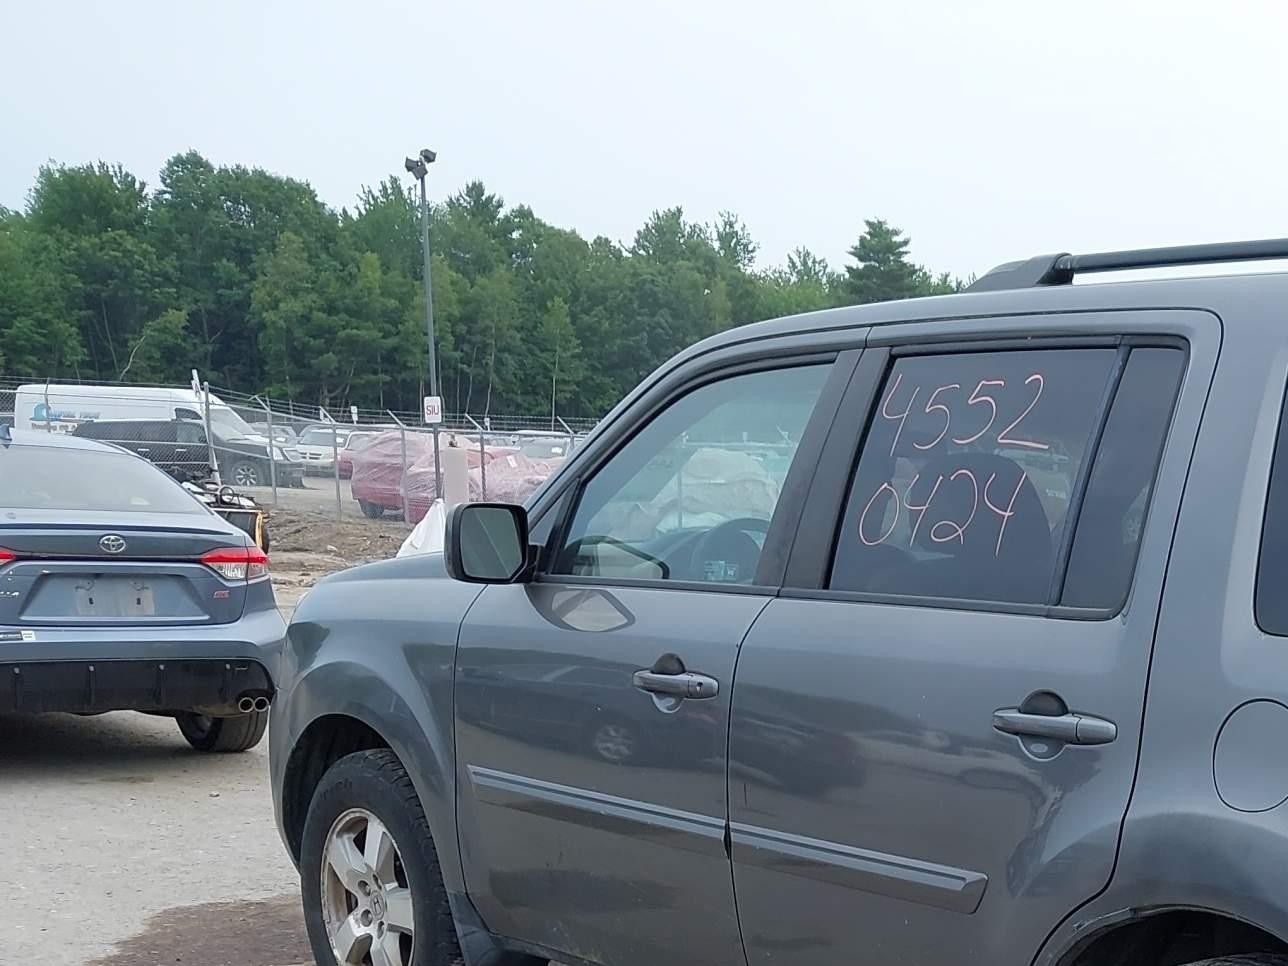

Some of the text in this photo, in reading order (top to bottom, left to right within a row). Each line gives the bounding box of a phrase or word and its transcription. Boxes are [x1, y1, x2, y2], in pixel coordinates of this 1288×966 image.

[426, 405, 440, 416] SIU
[881, 373, 1050, 457] 4552
[857, 468, 1028, 558] 0424
